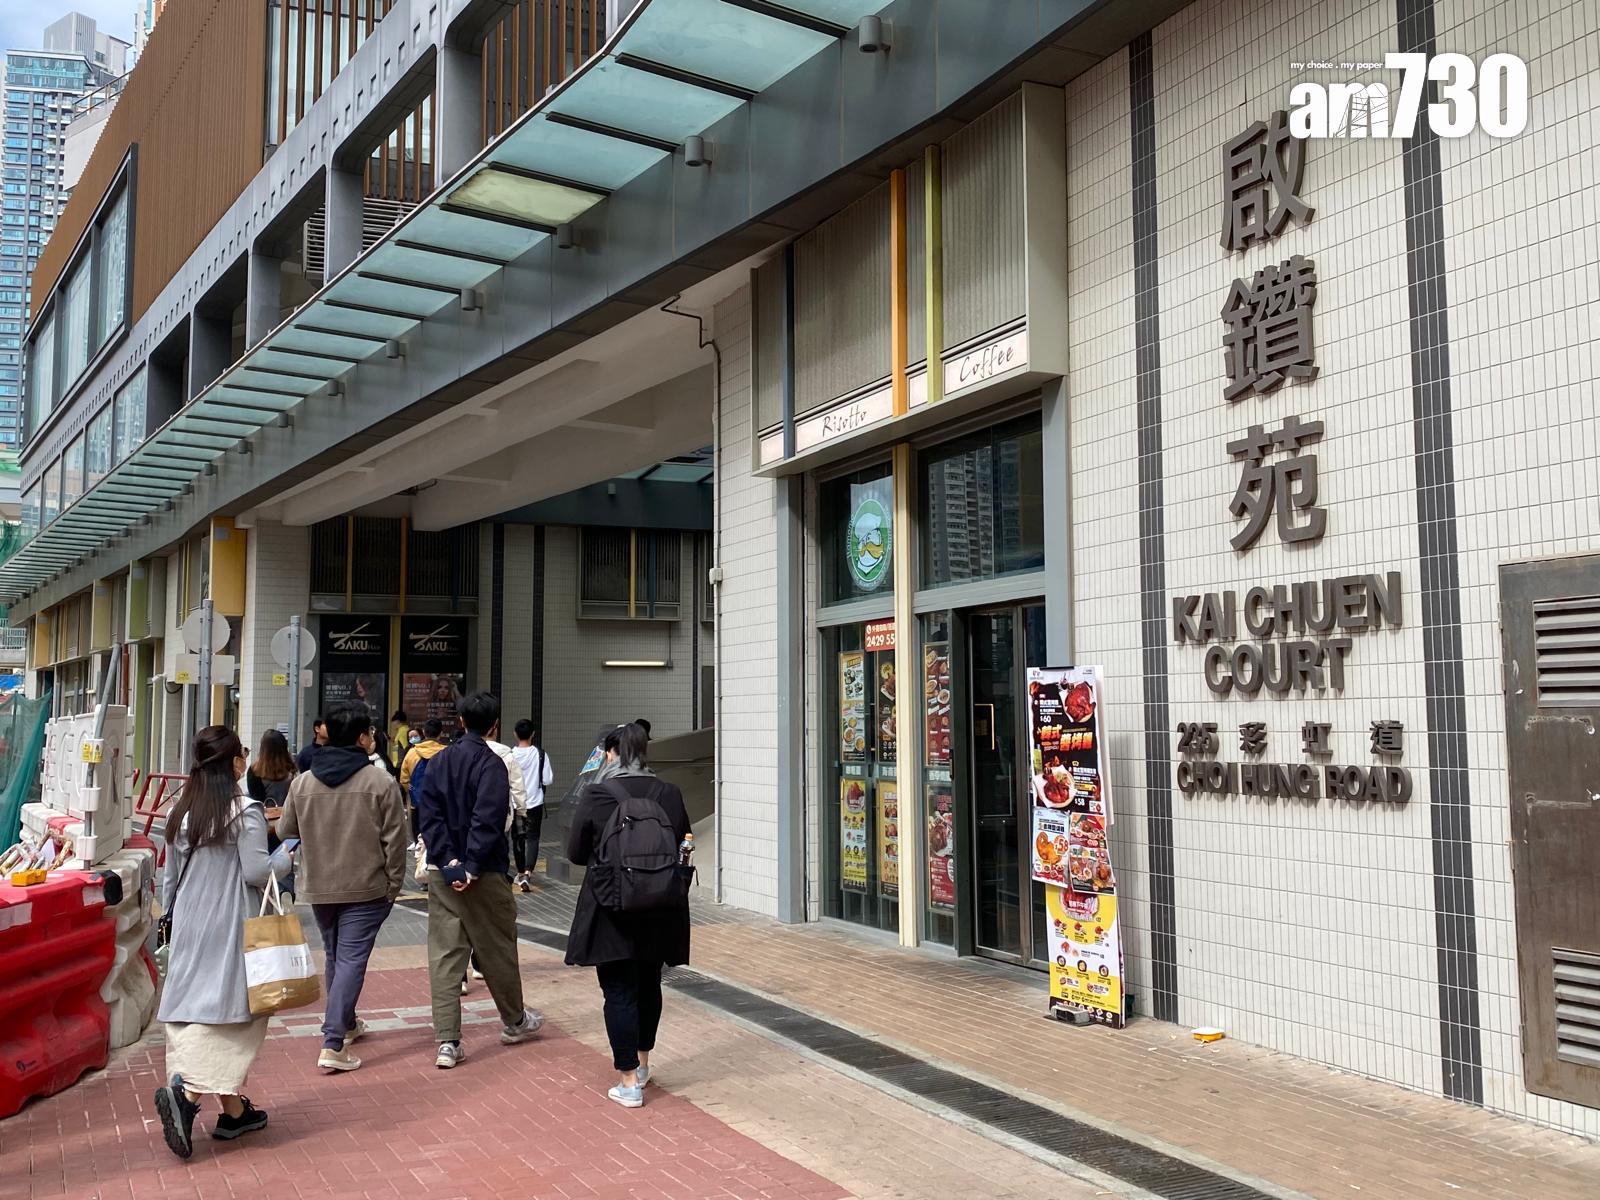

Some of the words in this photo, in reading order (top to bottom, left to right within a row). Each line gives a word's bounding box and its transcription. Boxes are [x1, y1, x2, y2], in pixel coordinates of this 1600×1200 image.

[959, 344, 1014, 382] Coffee
[822, 404, 867, 438] Risotto
[1173, 590, 1237, 643] KAI
[1244, 571, 1403, 637] CHUEN
[866, 634, 885, 648] 2429
[885, 633, 895, 645] 55
[1204, 638, 1353, 693] COURT
[1177, 722, 1219, 753] 225
[1239, 720, 1404, 754] 彩虹道
[1177, 762, 1238, 794] CHOI
[1241, 763, 1319, 799] HUNG
[1325, 765, 1413, 802] ROAD
